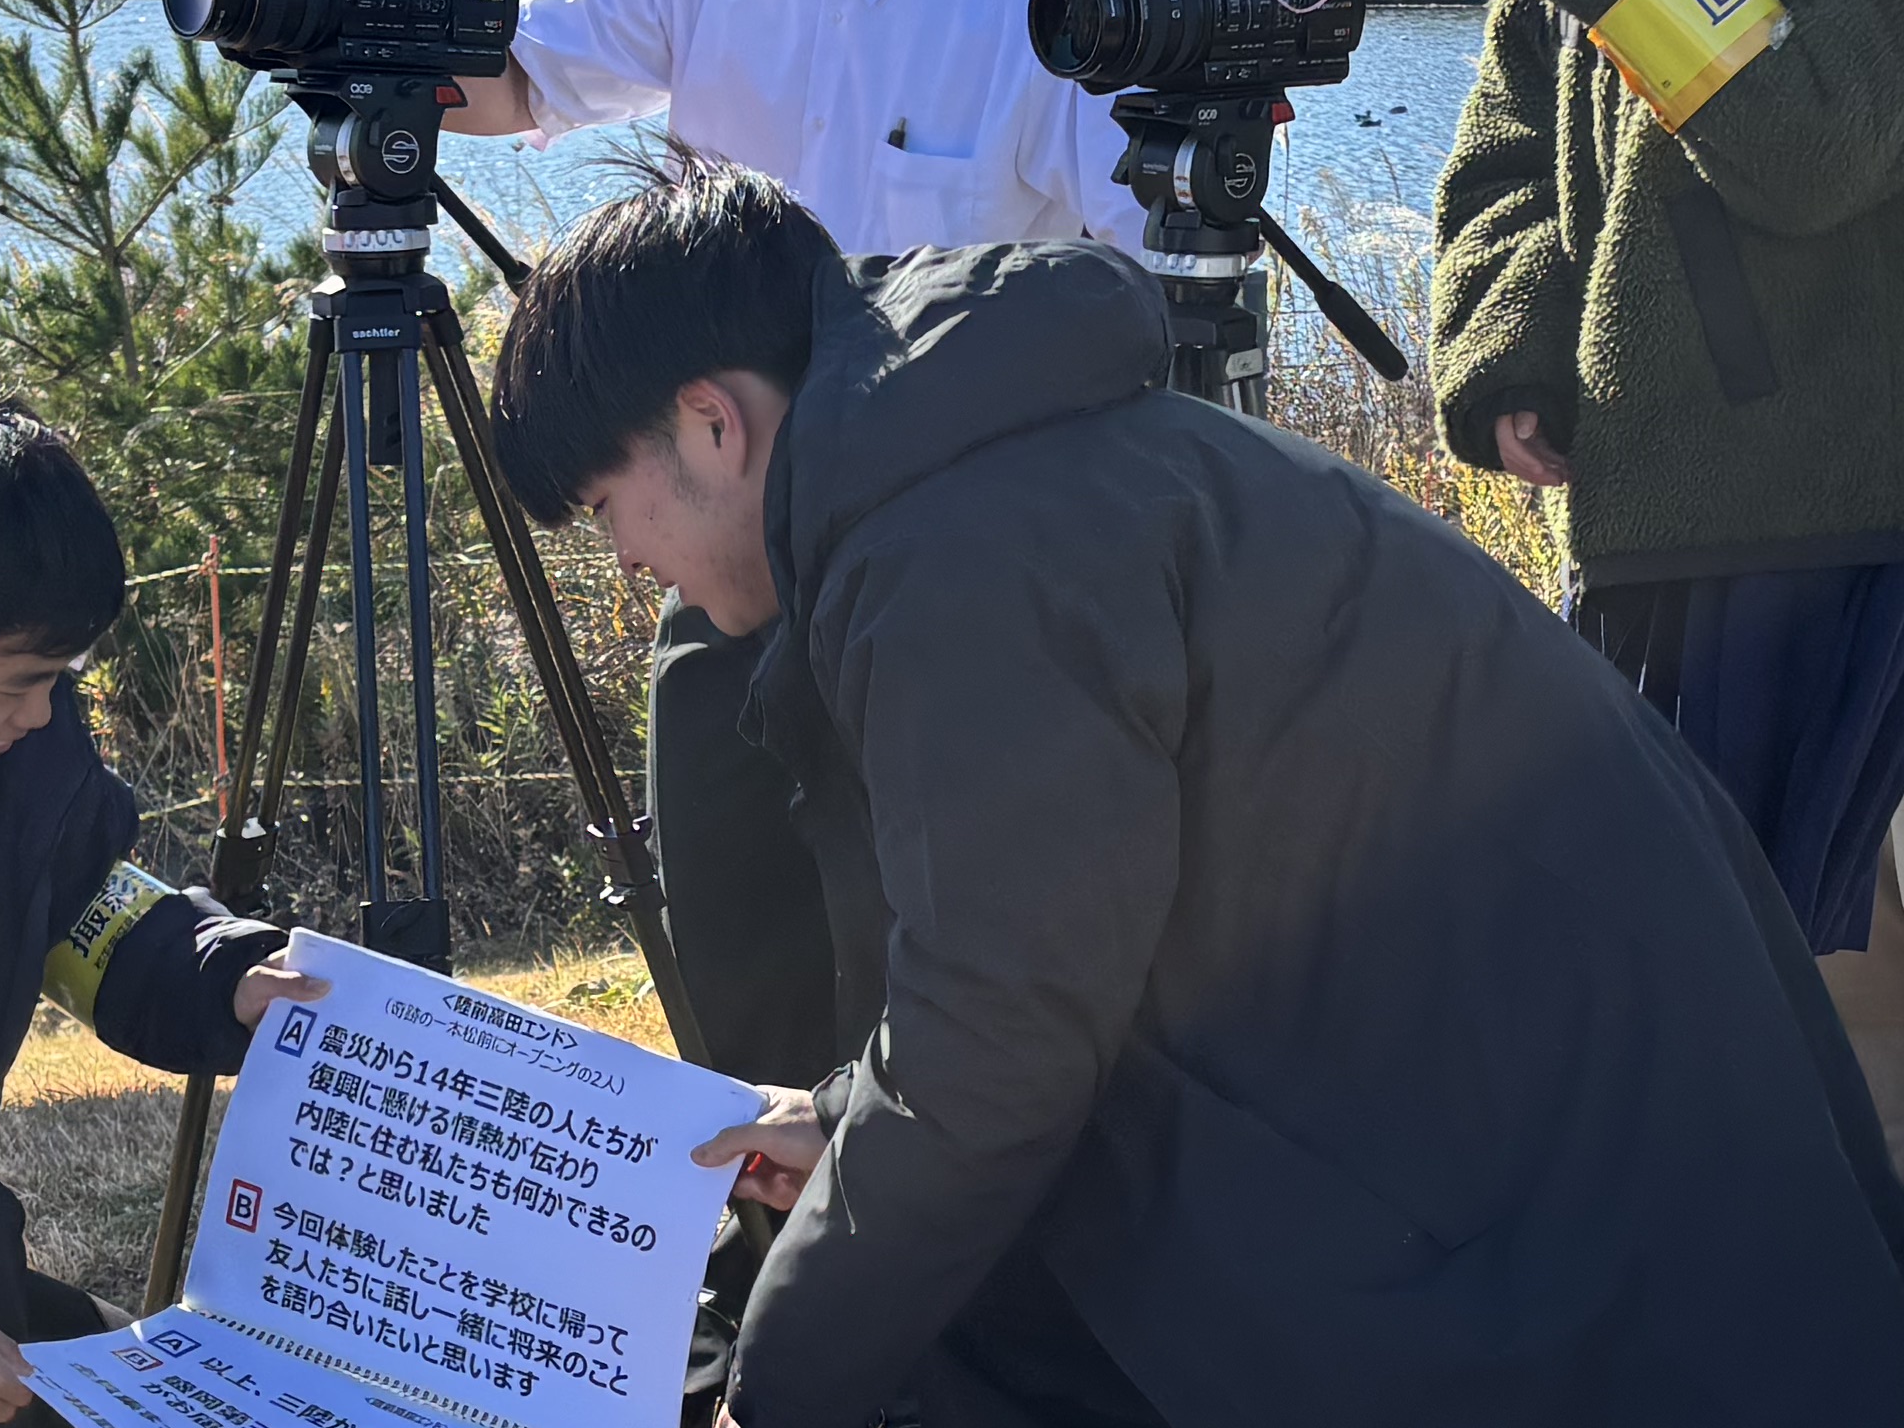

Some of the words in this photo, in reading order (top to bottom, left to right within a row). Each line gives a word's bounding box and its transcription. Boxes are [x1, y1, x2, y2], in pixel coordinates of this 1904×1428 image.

[352, 327, 401, 339] sachtler
[306, 1060, 599, 1190] 復興に懸ける情熱が伝わり
[317, 1022, 659, 1165] 震災から14年三陸の人たちが
[288, 1135, 492, 1236] では？と思いました
[294, 1099, 658, 1253] 内陸に住む私たちも何かできるの
[259, 1273, 541, 1397] を語り合いたいと思います
[264, 1238, 630, 1397] 友人たちに話し一緒に将来のこと
[272, 1201, 630, 1356] 今回体験したことを学校に帰って
